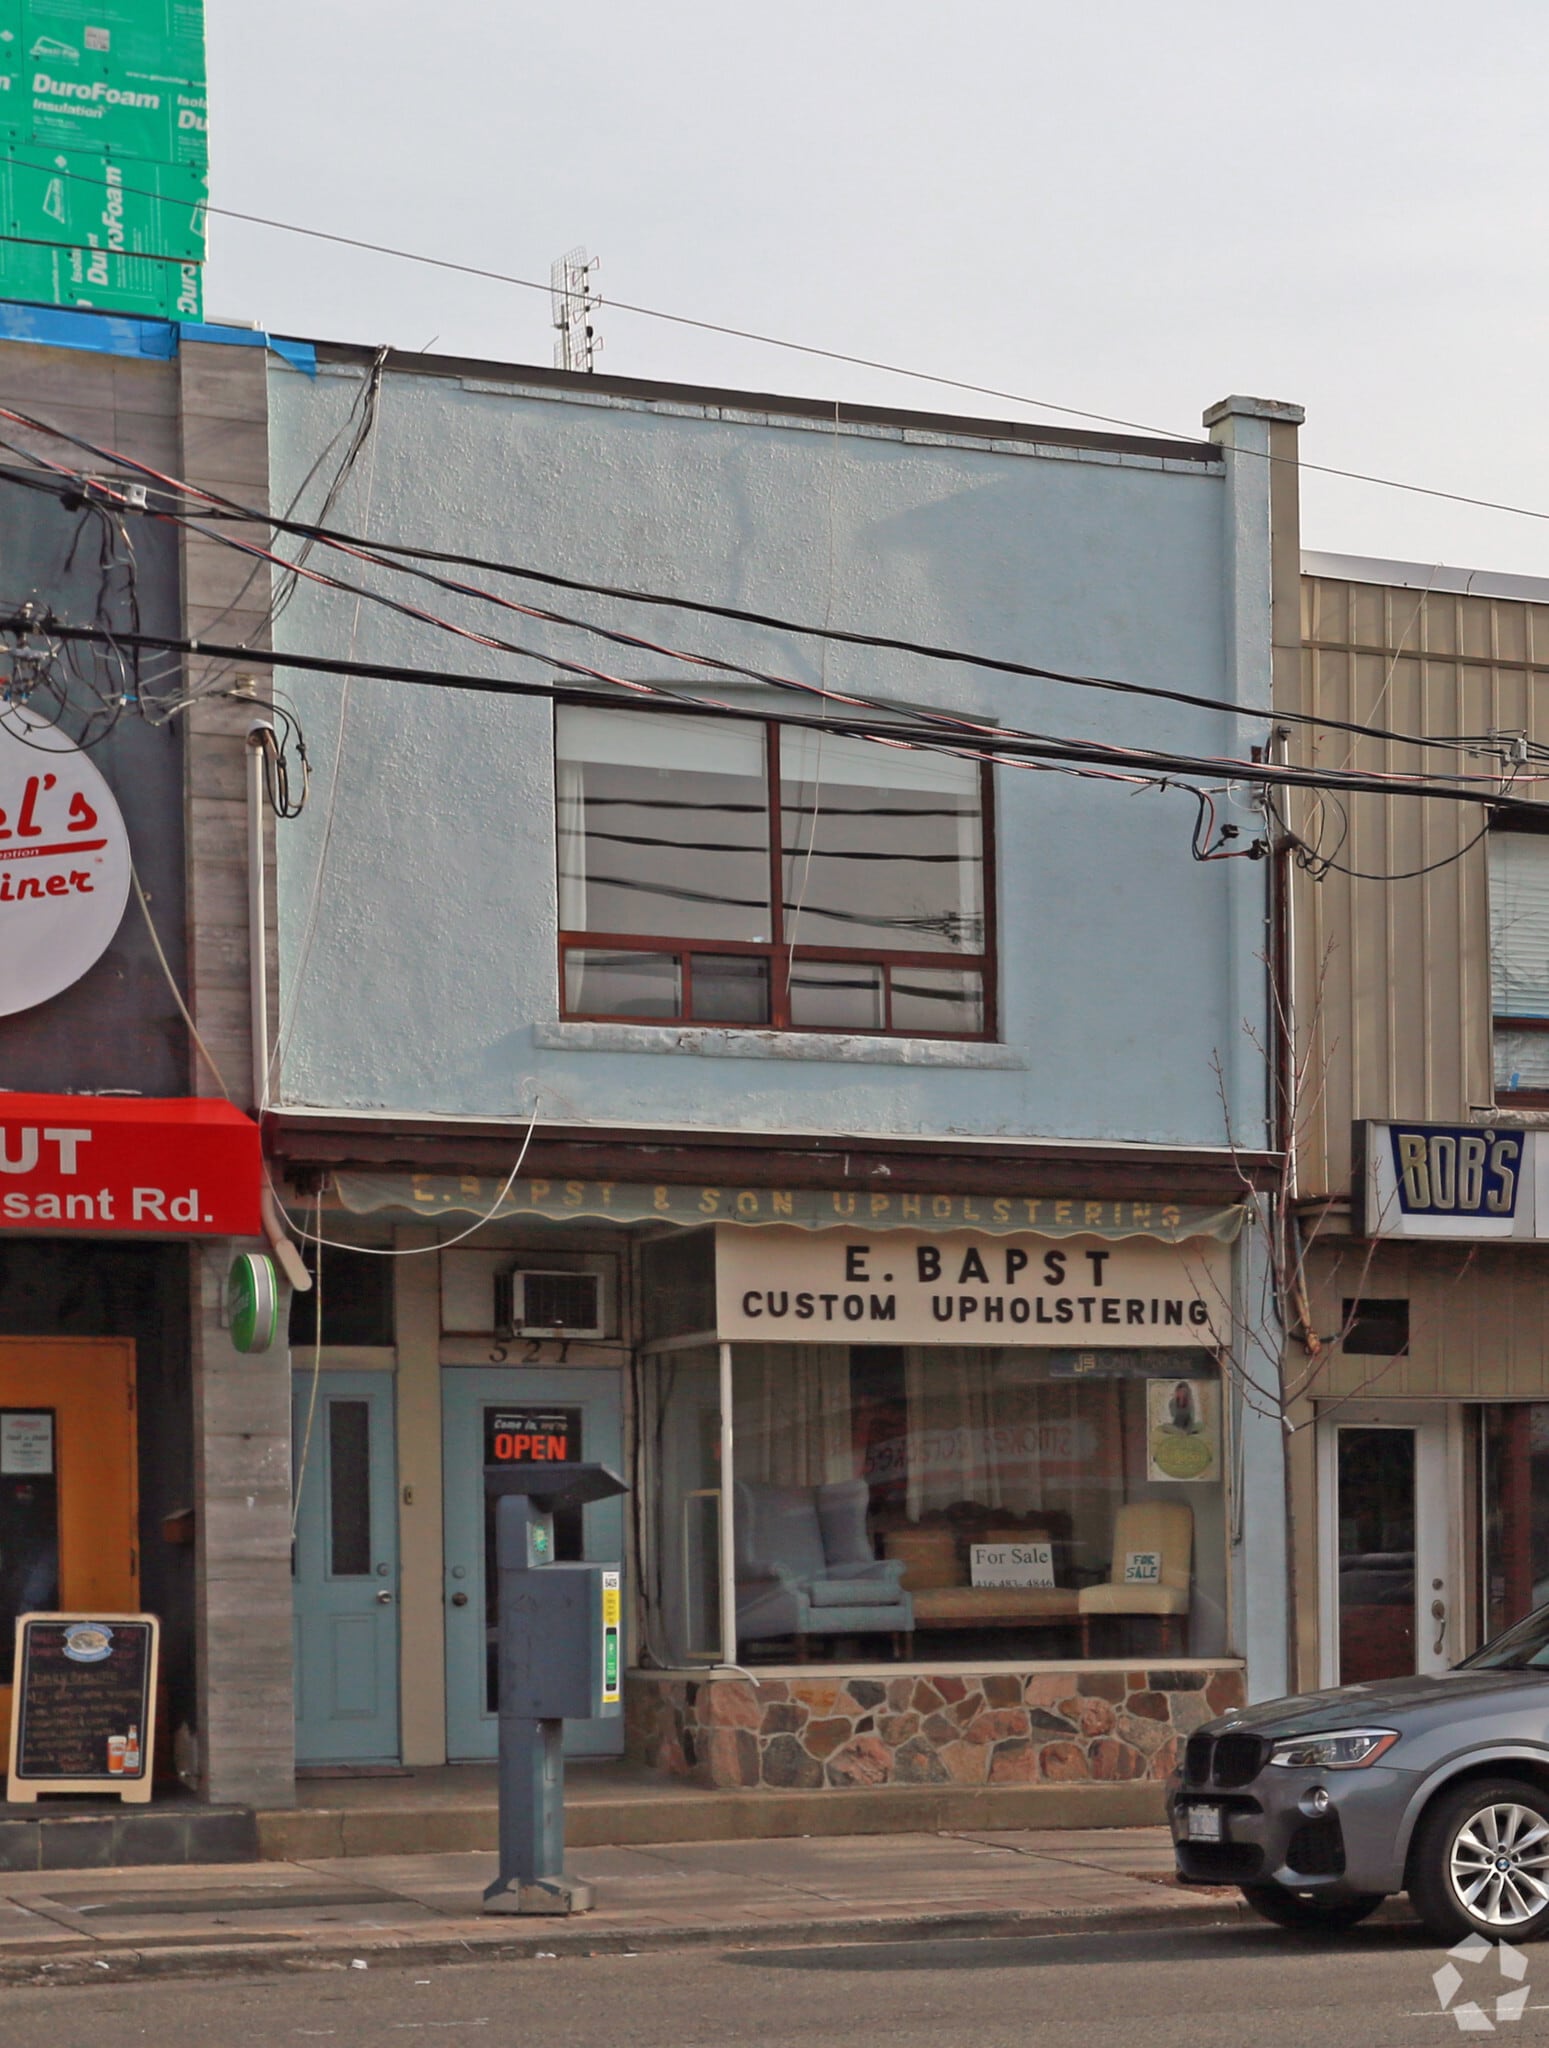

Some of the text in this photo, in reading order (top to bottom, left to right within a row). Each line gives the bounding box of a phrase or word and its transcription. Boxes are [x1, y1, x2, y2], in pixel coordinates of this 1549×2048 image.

[32, 73, 160, 109] DuroFoam
[33, 98, 103, 118] Insulation
[1398, 1129, 1519, 1213] BOB'S
[3, 1187, 213, 1223] sant Rd.
[459, 1175, 617, 1208] BAPST
[699, 1187, 793, 1216] SON
[832, 1191, 1182, 1228] UPHOLSTERING
[845, 1246, 1110, 1287] E. BAPST
[742, 1291, 1208, 1326] CUSTOM UPHOLSTERING
[494, 1432, 567, 1460] OPEN
[975, 1548, 1049, 1565] For Sale
[1126, 1554, 1158, 1579] FOR SALE
